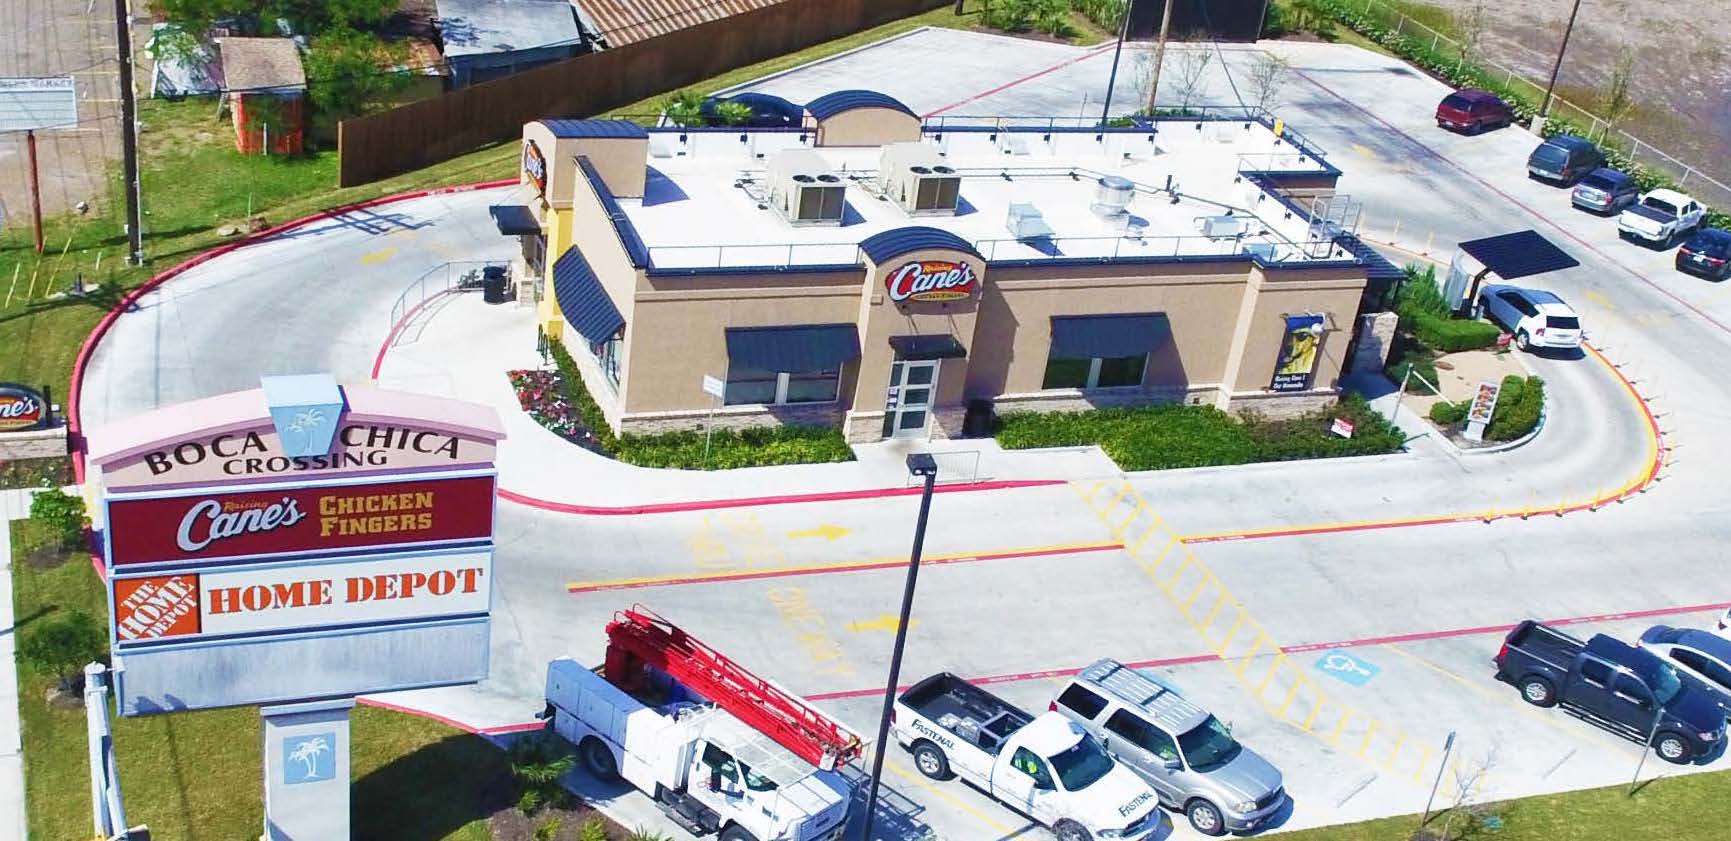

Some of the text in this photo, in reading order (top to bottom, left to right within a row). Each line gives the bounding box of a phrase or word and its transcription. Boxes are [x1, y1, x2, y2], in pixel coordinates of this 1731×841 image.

[889, 262, 976, 301] Cane's
[144, 425, 459, 476] BOCA CHICA
[223, 450, 388, 475] CROSSING
[223, 500, 269, 513] Raising
[319, 492, 435, 516] CHICKEN
[177, 497, 307, 551] Cane's
[320, 512, 433, 537] FINGERS
[117, 576, 195, 640] HOME
[120, 581, 160, 611] THE
[208, 568, 484, 615] HOME DEPOT
[146, 594, 198, 639] DEPOT
